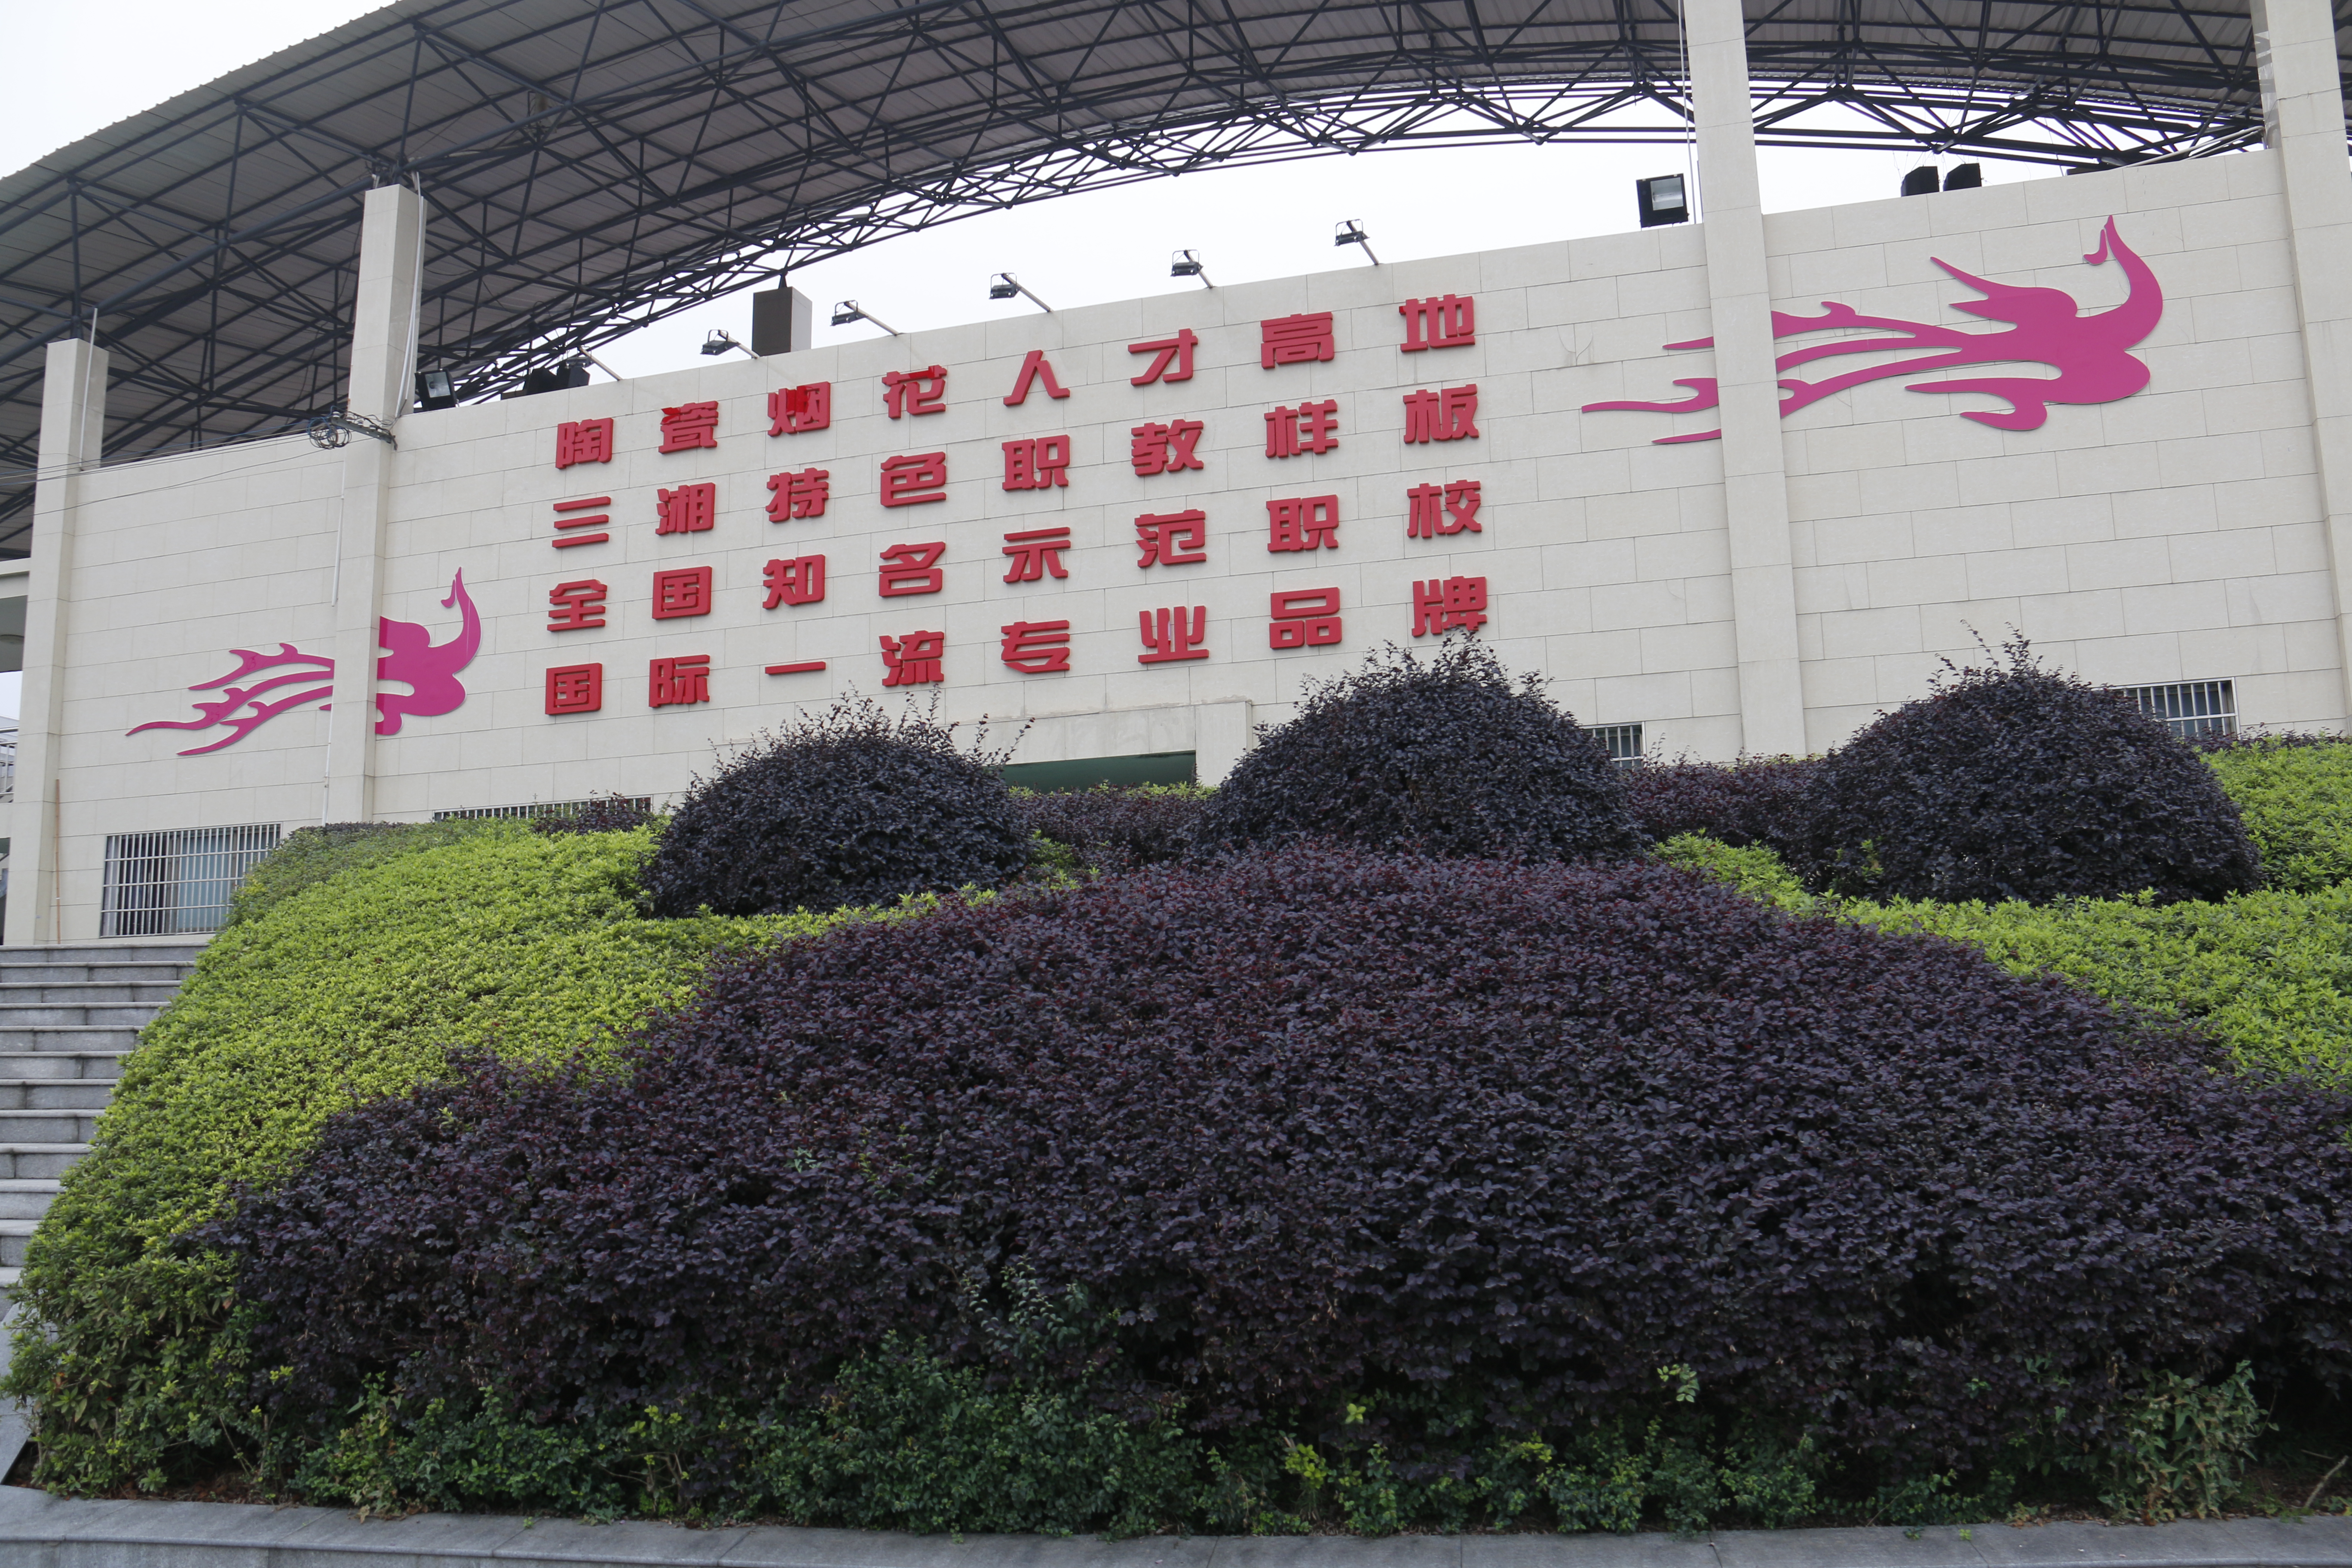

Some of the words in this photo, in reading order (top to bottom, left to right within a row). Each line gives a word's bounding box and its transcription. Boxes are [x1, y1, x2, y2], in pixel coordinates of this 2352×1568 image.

[555, 294, 1475, 469] 陶瓷烟花人才高地
[552, 383, 1479, 548] 三湘特色职教样板
[547, 479, 1482, 631] 全国知名示范职校
[545, 576, 1488, 715] 国际一流专业品牌
